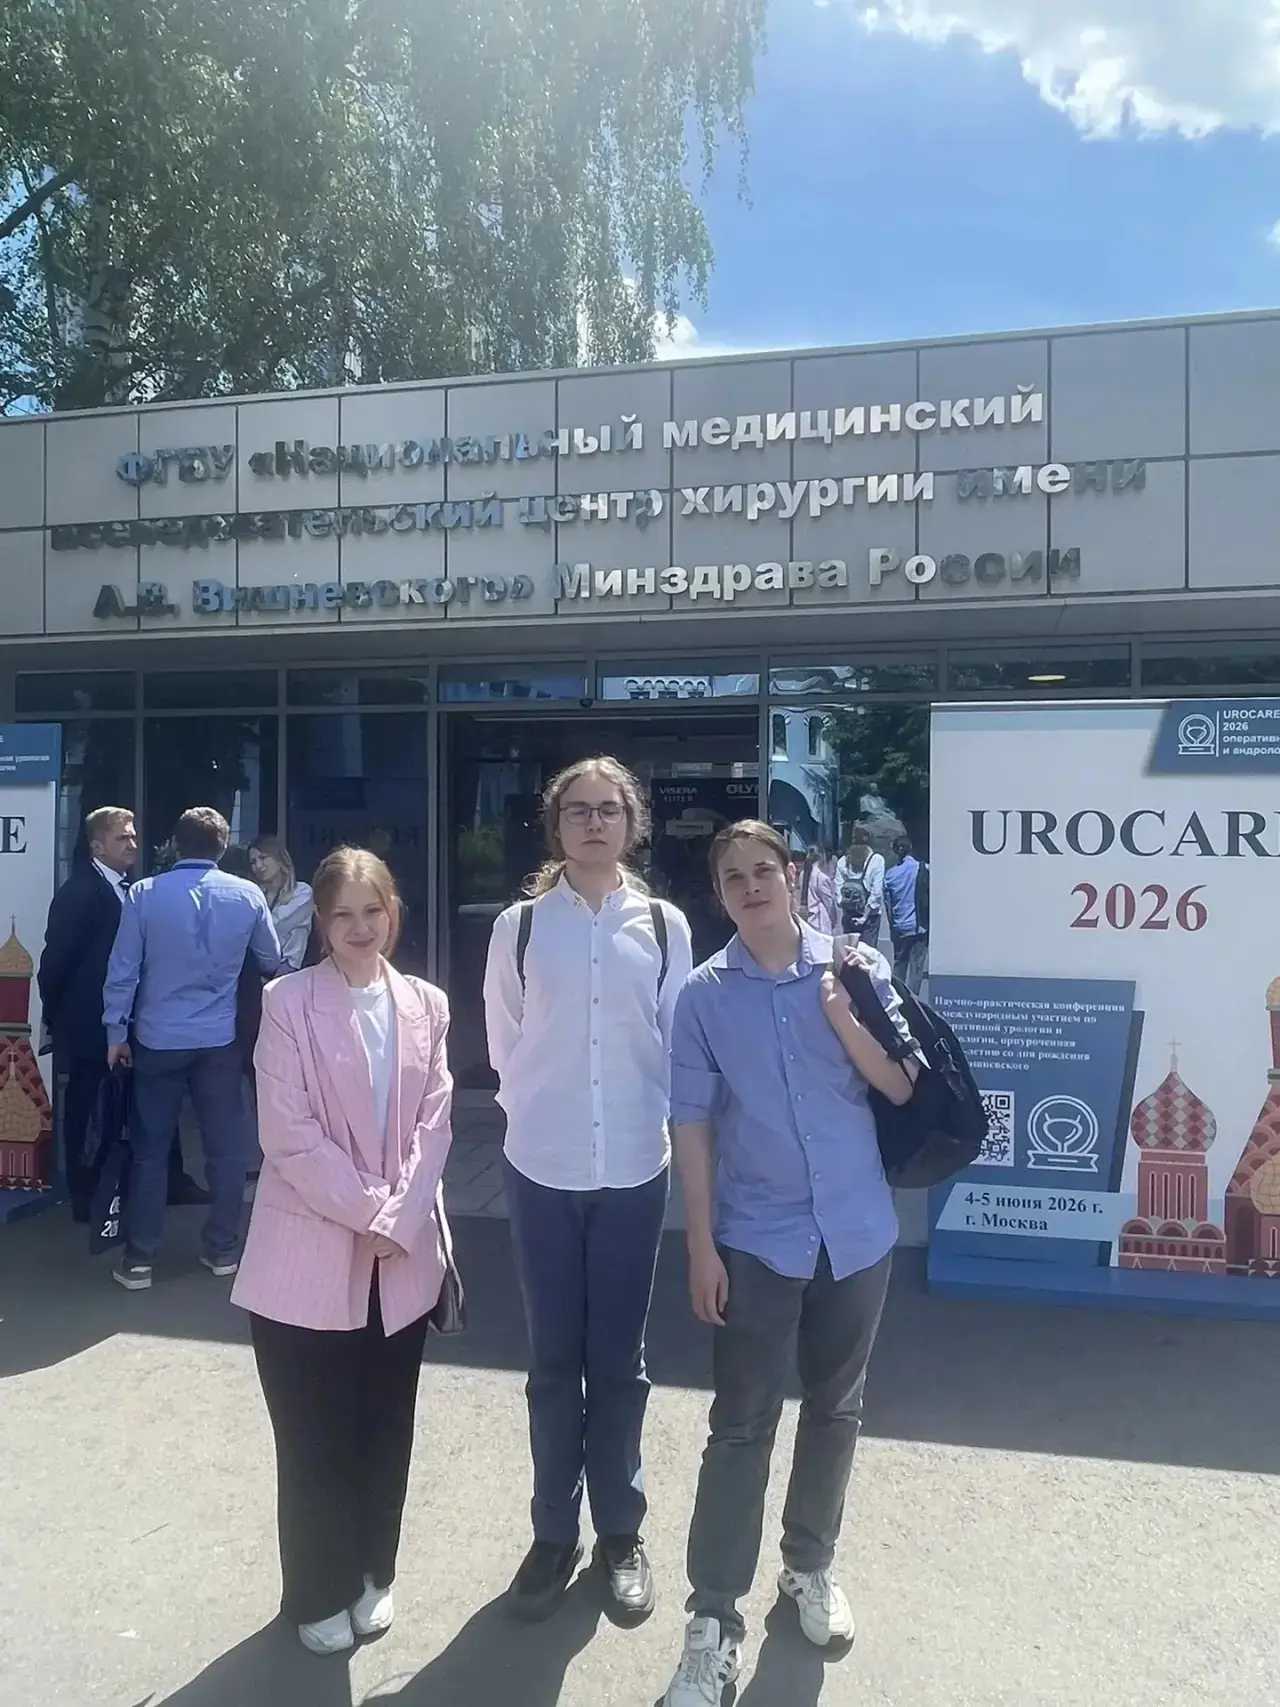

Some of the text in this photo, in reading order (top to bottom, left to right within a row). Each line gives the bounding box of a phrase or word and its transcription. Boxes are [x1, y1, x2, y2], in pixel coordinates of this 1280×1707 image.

[663, 383, 1043, 450] медицинский
[519, 488, 664, 531] центр
[681, 472, 934, 520] хирургии
[956, 459, 1146, 498] имени
[553, 558, 848, 601] Минздрава
[869, 547, 1081, 586] России
[1223, 721, 1249, 731] 2026
[1222, 747, 1230, 755] и
[726, 783, 759, 794] OLY
[967, 809, 1280, 857] UROCAR
[1069, 882, 1208, 931] 2026
[935, 996, 1126, 1013] Научно-практическая конференция
[1031, 1015, 1081, 1024] участием
[1084, 1016, 1097, 1024] по
[1003, 1026, 1053, 1036] урологии
[1000, 1038, 1076, 1048] приуроченная
[1002, 1050, 1014, 1058] со
[1038, 1052, 1091, 1062] рождения
[969, 1061, 1030, 1071] ишневского
[965, 1191, 1103, 1214] 4-5 июня 2026 г.
[965, 1212, 1048, 1231] г. Москва
